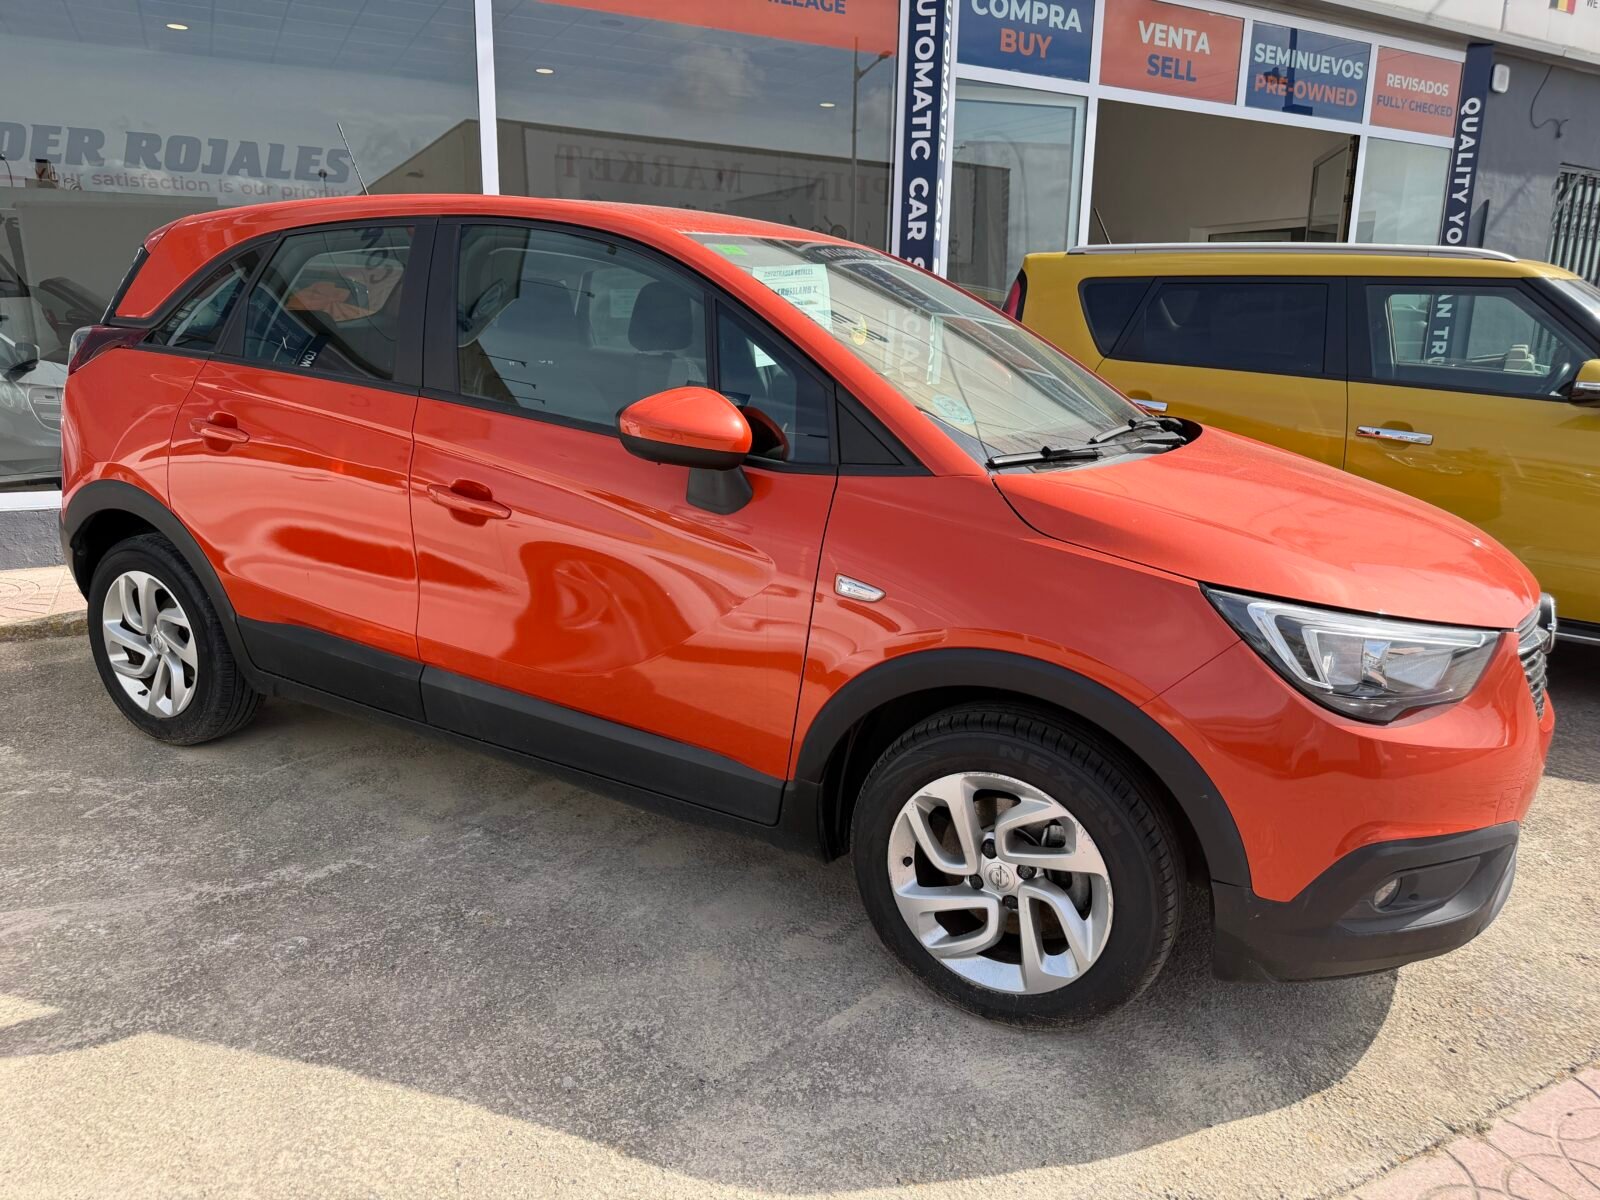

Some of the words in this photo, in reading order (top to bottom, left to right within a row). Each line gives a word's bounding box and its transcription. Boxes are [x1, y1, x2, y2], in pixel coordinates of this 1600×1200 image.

[971, 0, 1082, 33] COMPRA
[1001, 28, 1052, 58] BUY
[1138, 20, 1211, 55] VENTA
[1147, 54, 1198, 82] SELL
[1254, 43, 1364, 80] SEMINUEVOS
[1255, 73, 1358, 107] PRE-OWNED
[1386, 73, 1449, 97] REVISADOS
[1376, 94, 1407, 110] FULLY
[1408, 100, 1453, 117] CHECKED
[0, 121, 105, 166] DER
[124, 131, 350, 184] ROJALES
[1451, 97, 1481, 204] QUALITY
[92, 172, 210, 192] satisfaction
[218, 178, 233, 193] is
[241, 182, 273, 197] our
[907, 177, 929, 240] CAR
[1446, 211, 1466, 244] YO
[999, 744, 1123, 837] NEXEN
